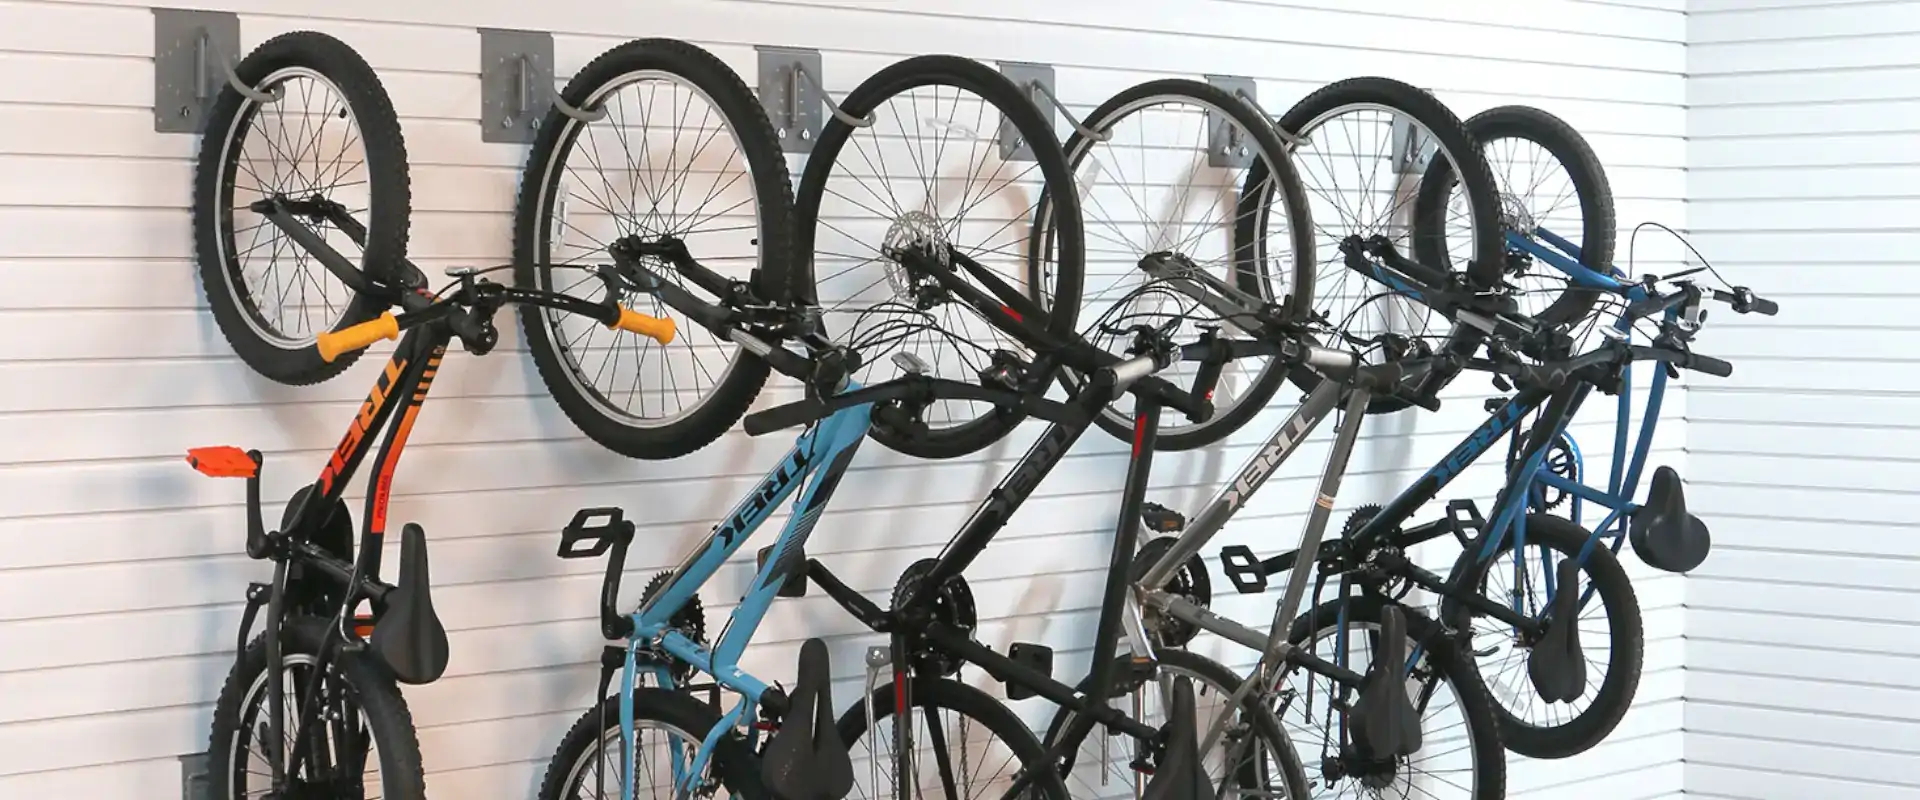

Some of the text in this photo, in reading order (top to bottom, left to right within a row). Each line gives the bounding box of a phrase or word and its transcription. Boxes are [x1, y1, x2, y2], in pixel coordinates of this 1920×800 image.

[318, 358, 408, 497] TREK
[988, 424, 1077, 518] TREK
[1221, 413, 1316, 512] TREK
[1434, 401, 1528, 487] TREK
[716, 449, 807, 549] TREK
